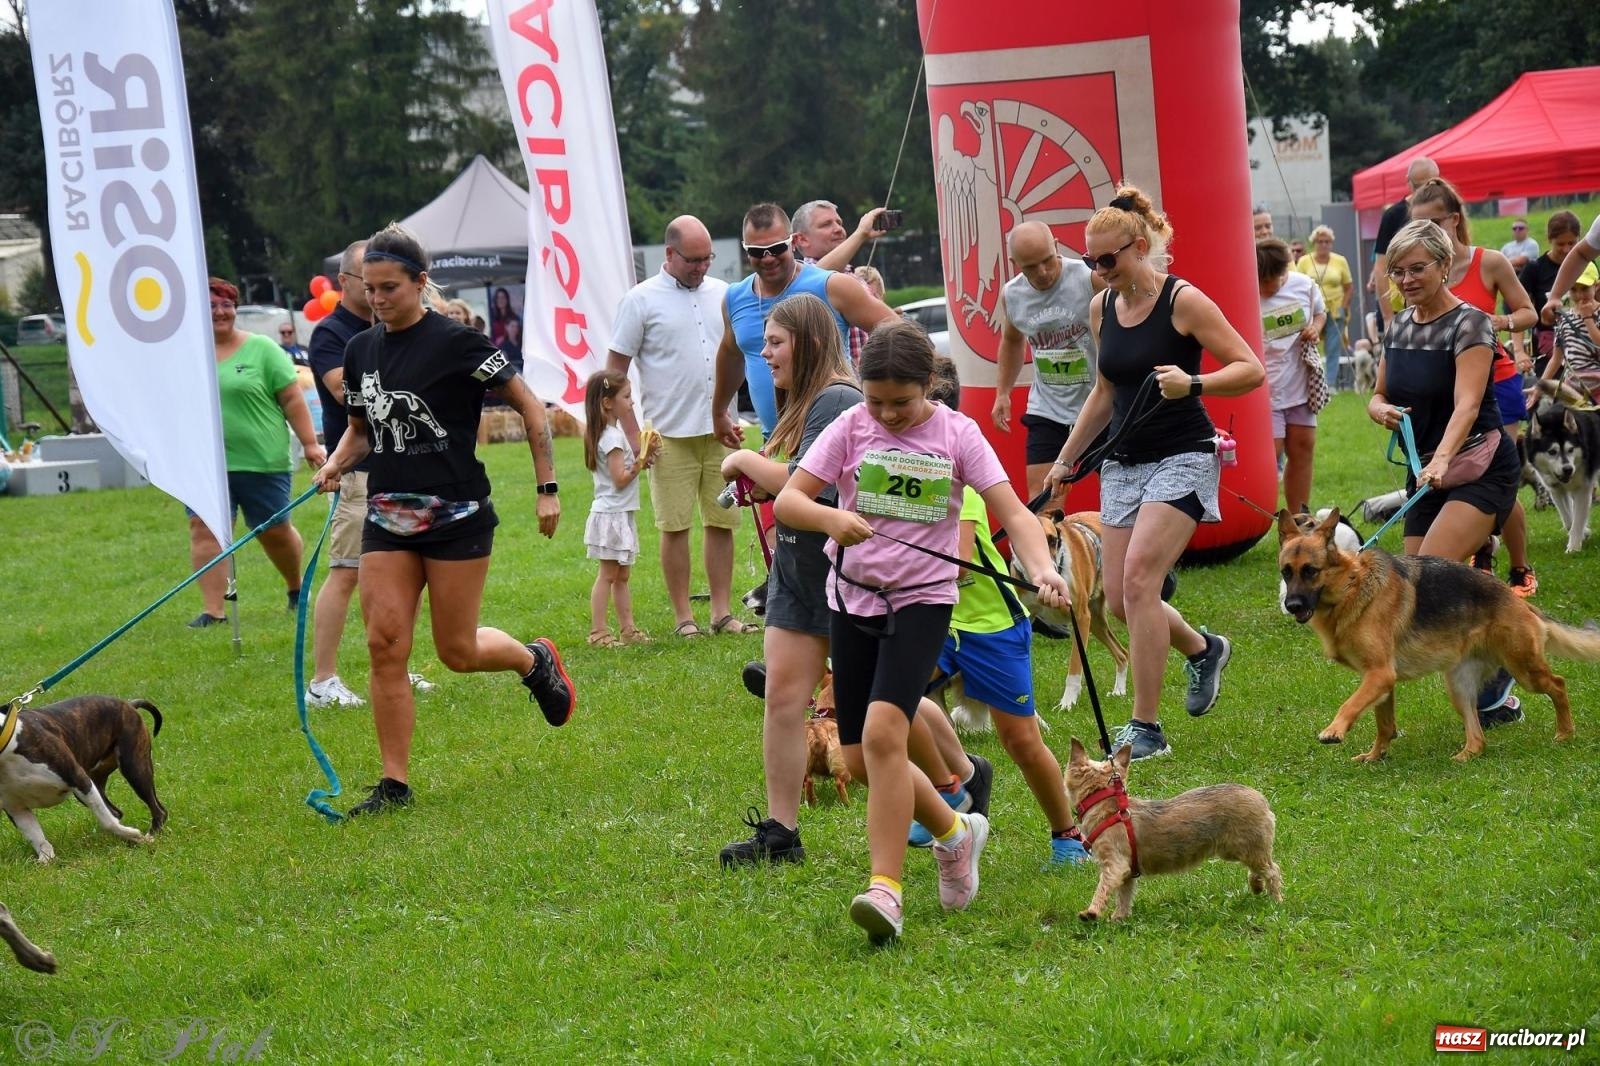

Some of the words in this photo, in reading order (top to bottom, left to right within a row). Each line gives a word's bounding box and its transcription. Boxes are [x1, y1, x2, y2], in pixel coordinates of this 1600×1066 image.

[1277, 314, 1293, 327] 69
[1052, 361, 1071, 374] 17
[407, 439, 449, 456] AMSAFF
[865, 452, 898, 463] ZOO-MAR
[899, 457, 952, 470] DOGTREKKING
[58, 470, 70, 493] 3
[886, 475, 922, 498] 26
